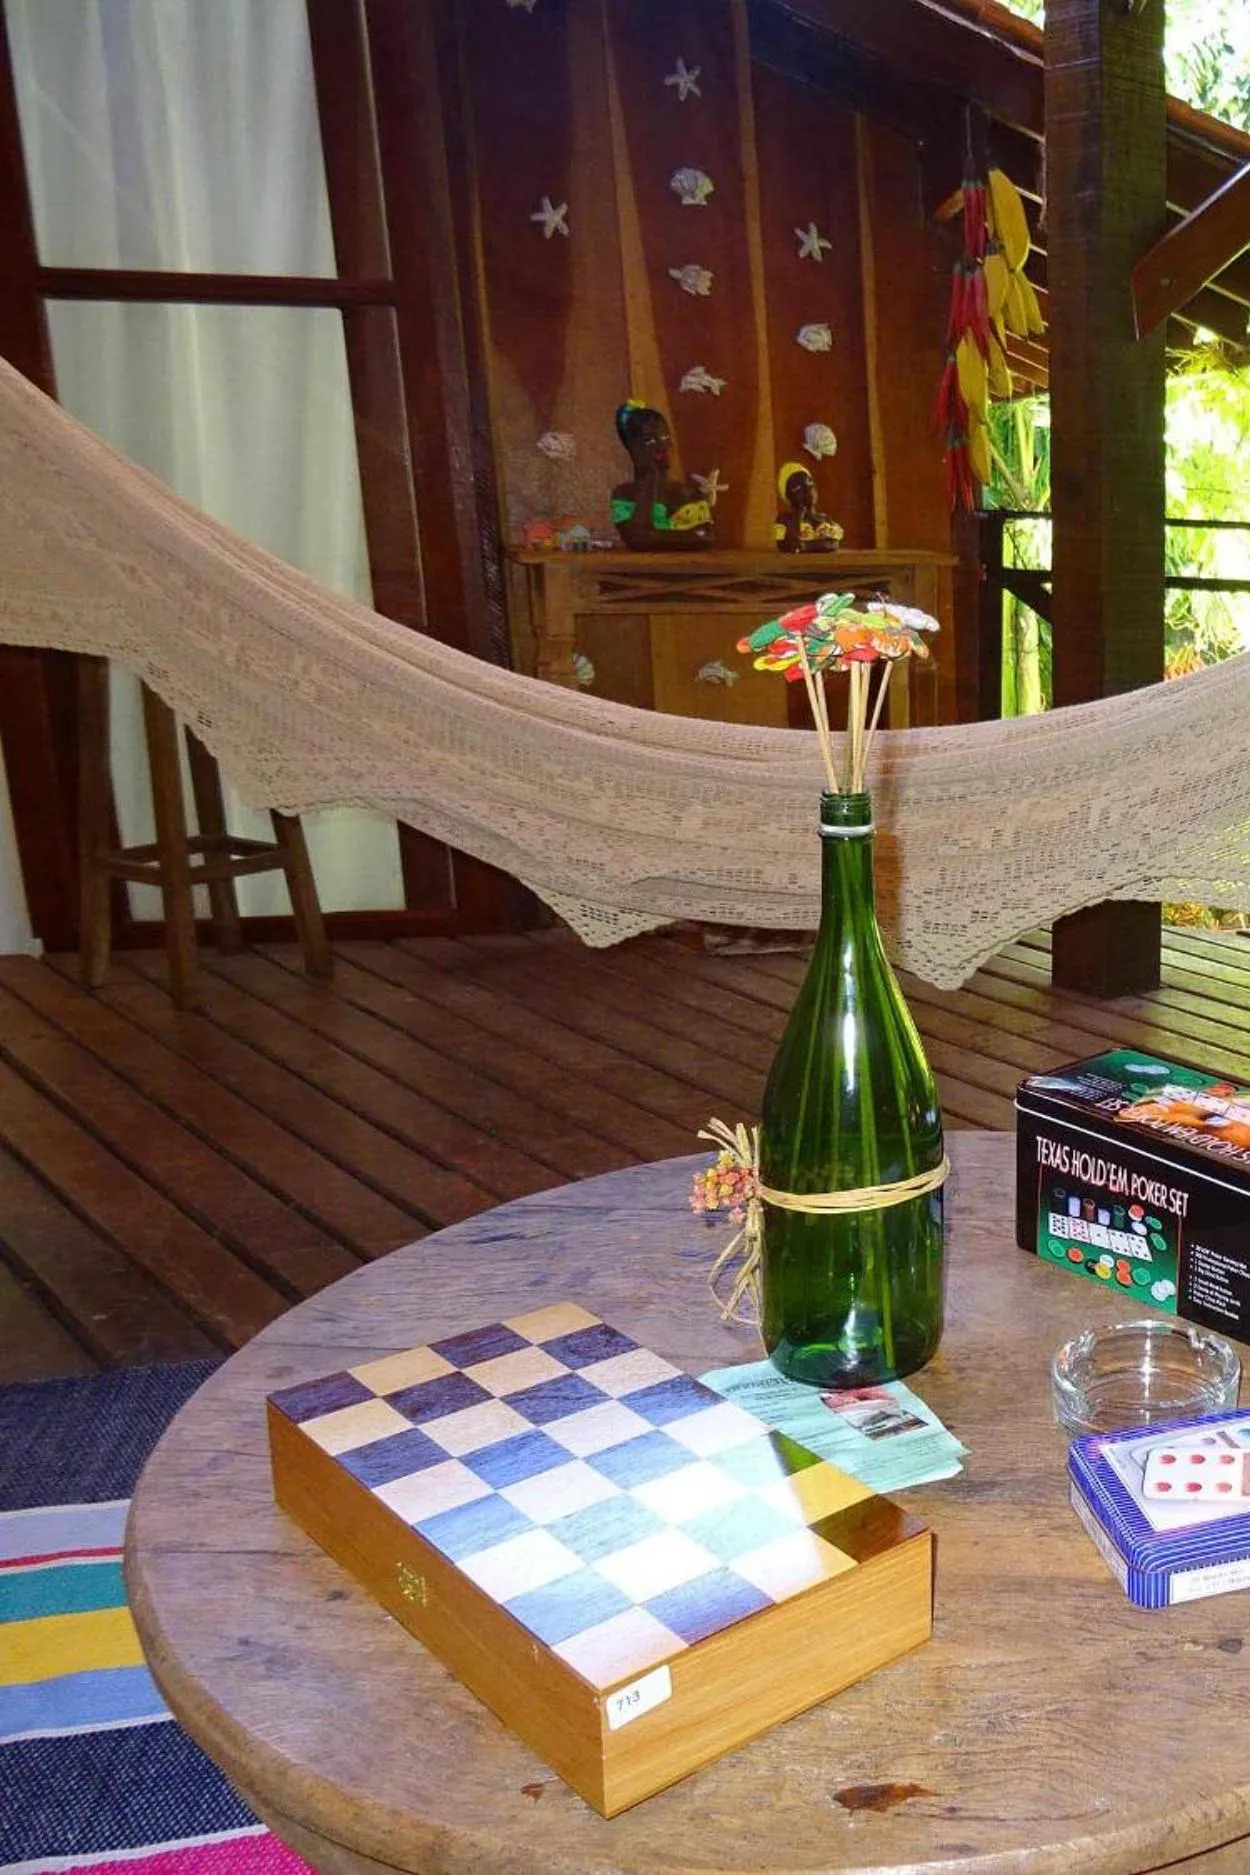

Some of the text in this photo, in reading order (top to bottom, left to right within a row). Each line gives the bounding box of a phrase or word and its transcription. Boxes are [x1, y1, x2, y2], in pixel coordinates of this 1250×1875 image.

[1036, 1136, 1189, 1217] TEXAS HOLD'EM POKER SET
[616, 1690, 640, 1711] 713
